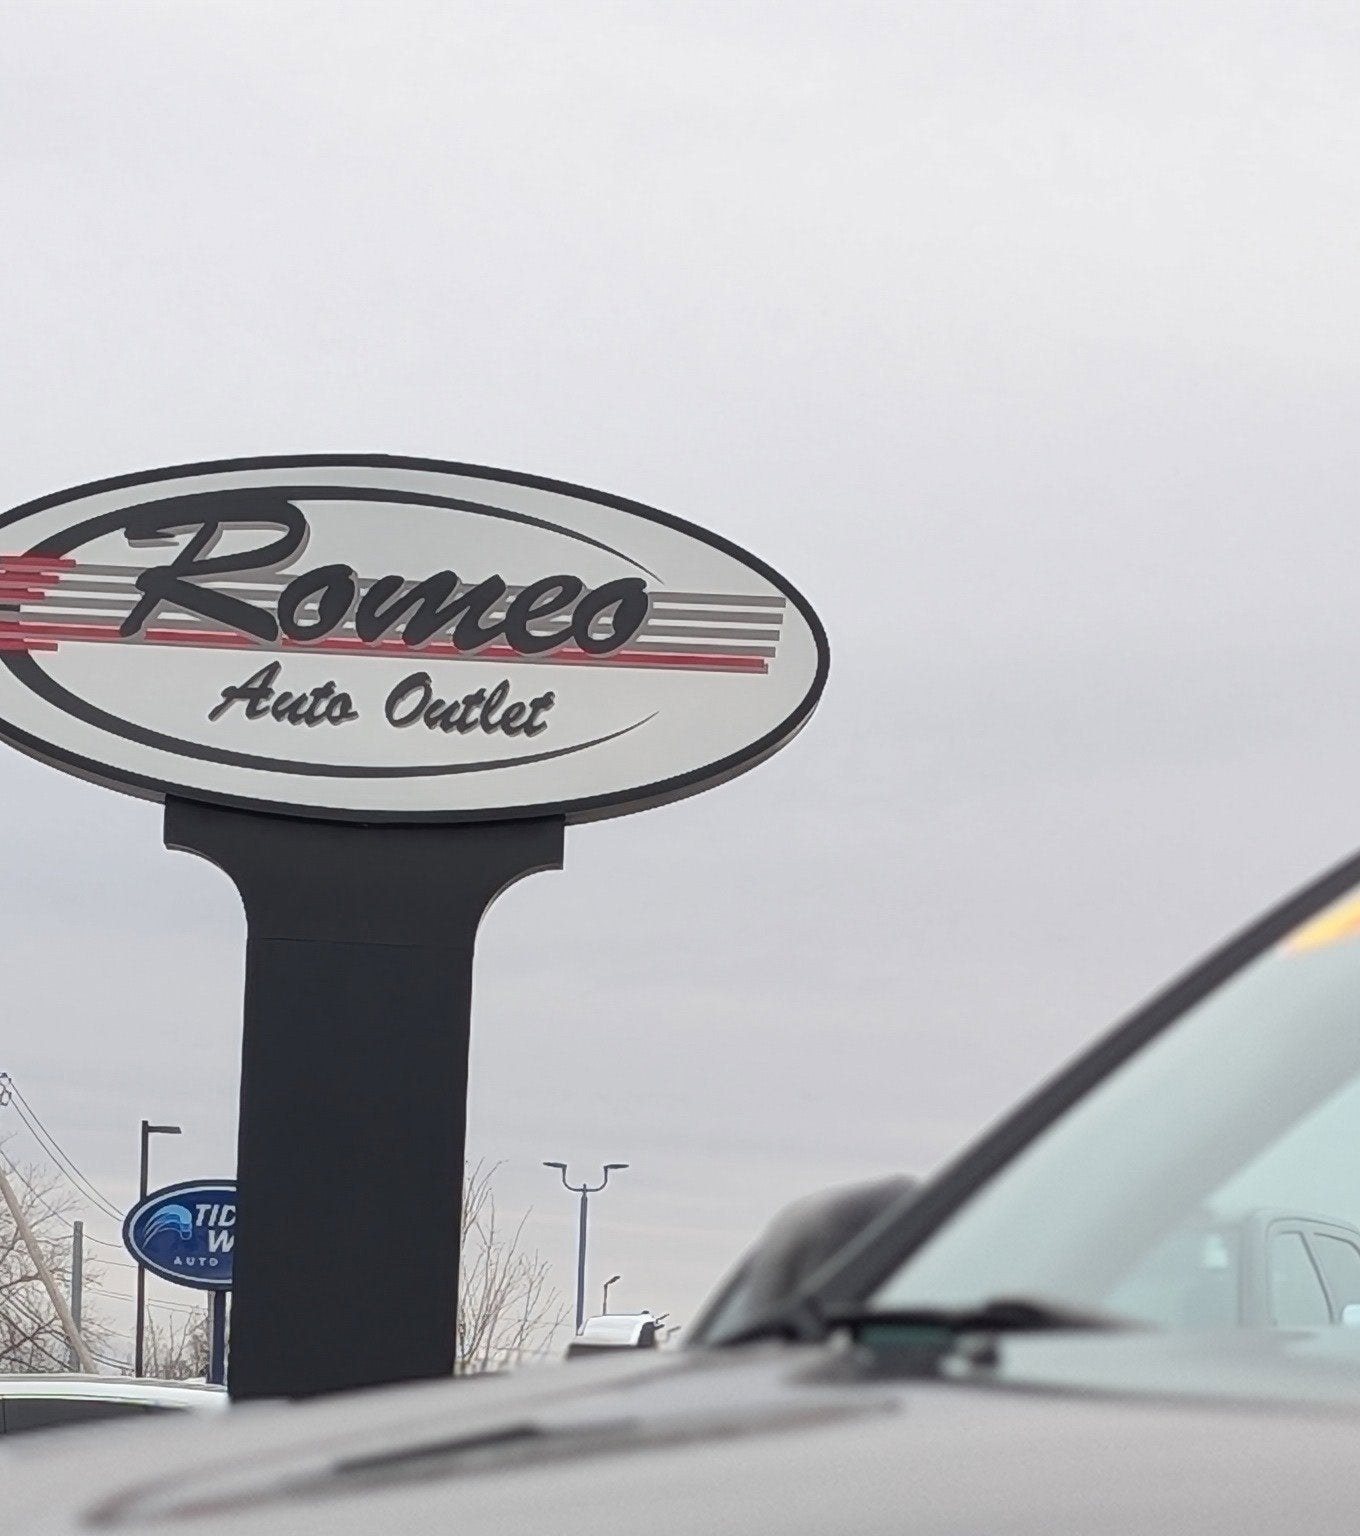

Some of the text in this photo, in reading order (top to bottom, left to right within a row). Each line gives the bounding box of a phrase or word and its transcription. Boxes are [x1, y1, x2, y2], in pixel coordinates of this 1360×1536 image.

[119, 487, 650, 656] Romeo
[208, 651, 556, 738] Auto Outlet
[173, 1256, 219, 1267] AUTO
